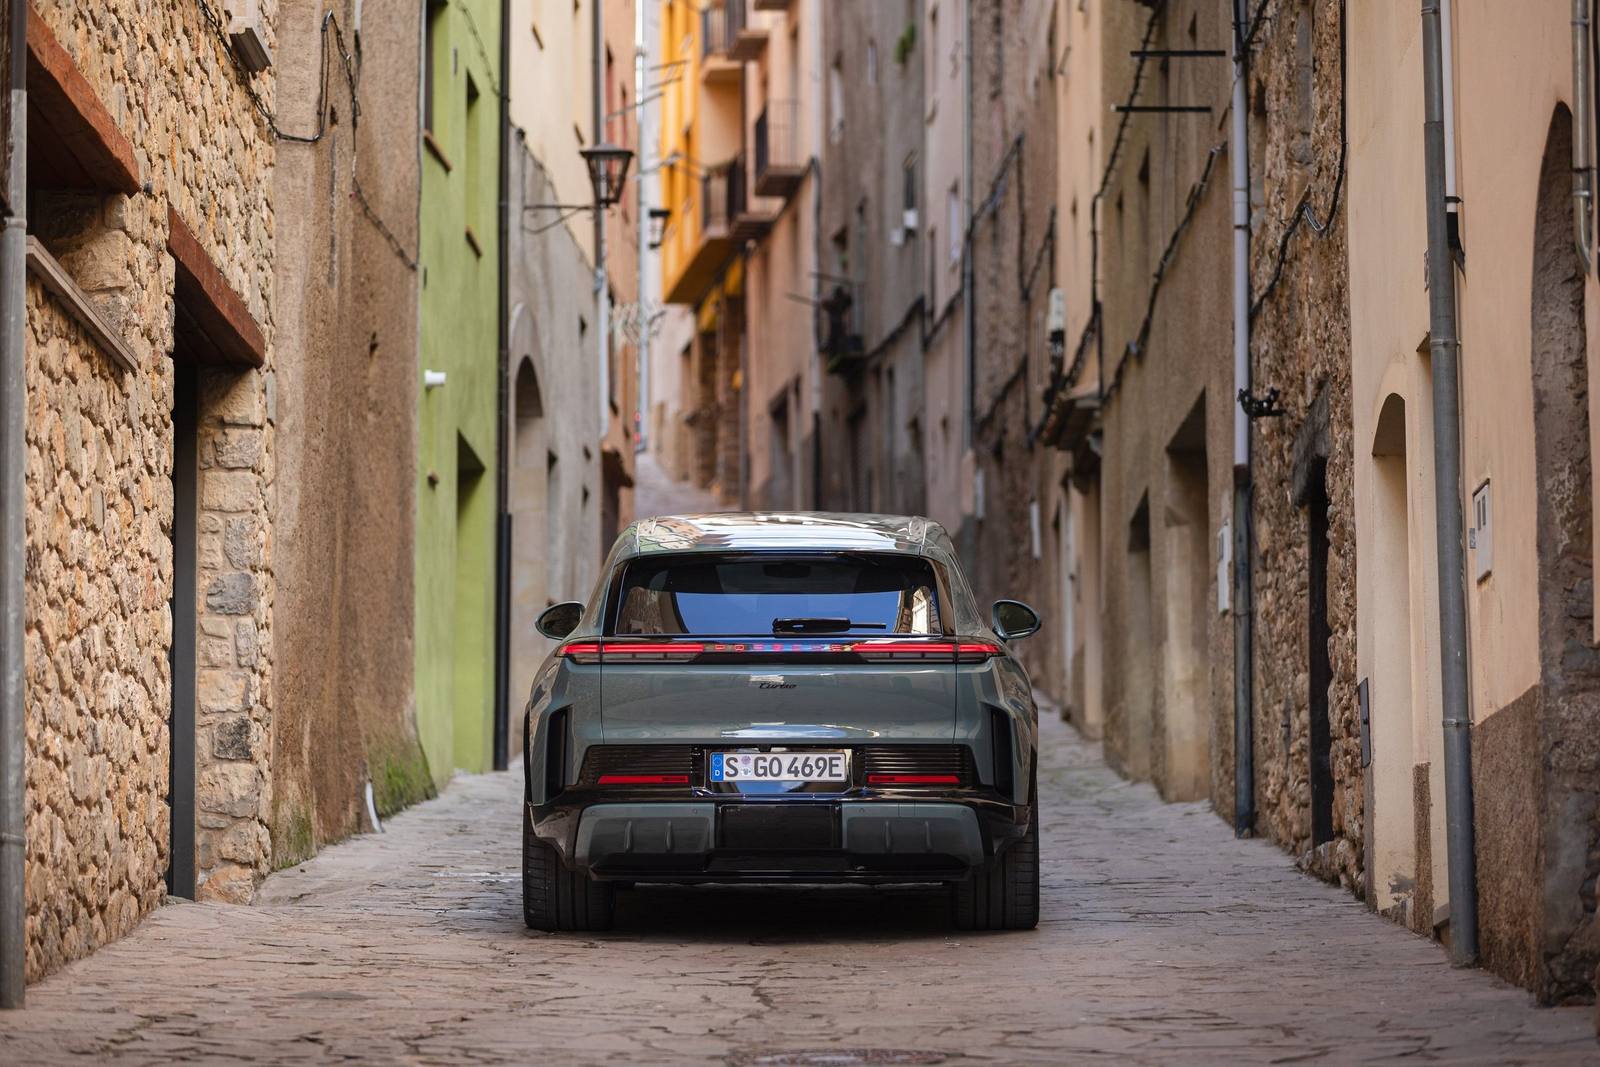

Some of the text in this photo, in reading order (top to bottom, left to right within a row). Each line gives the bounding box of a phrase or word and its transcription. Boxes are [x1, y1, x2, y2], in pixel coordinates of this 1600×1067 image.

[714, 769, 721, 777] D
[725, 756, 842, 778] S GO 469E
